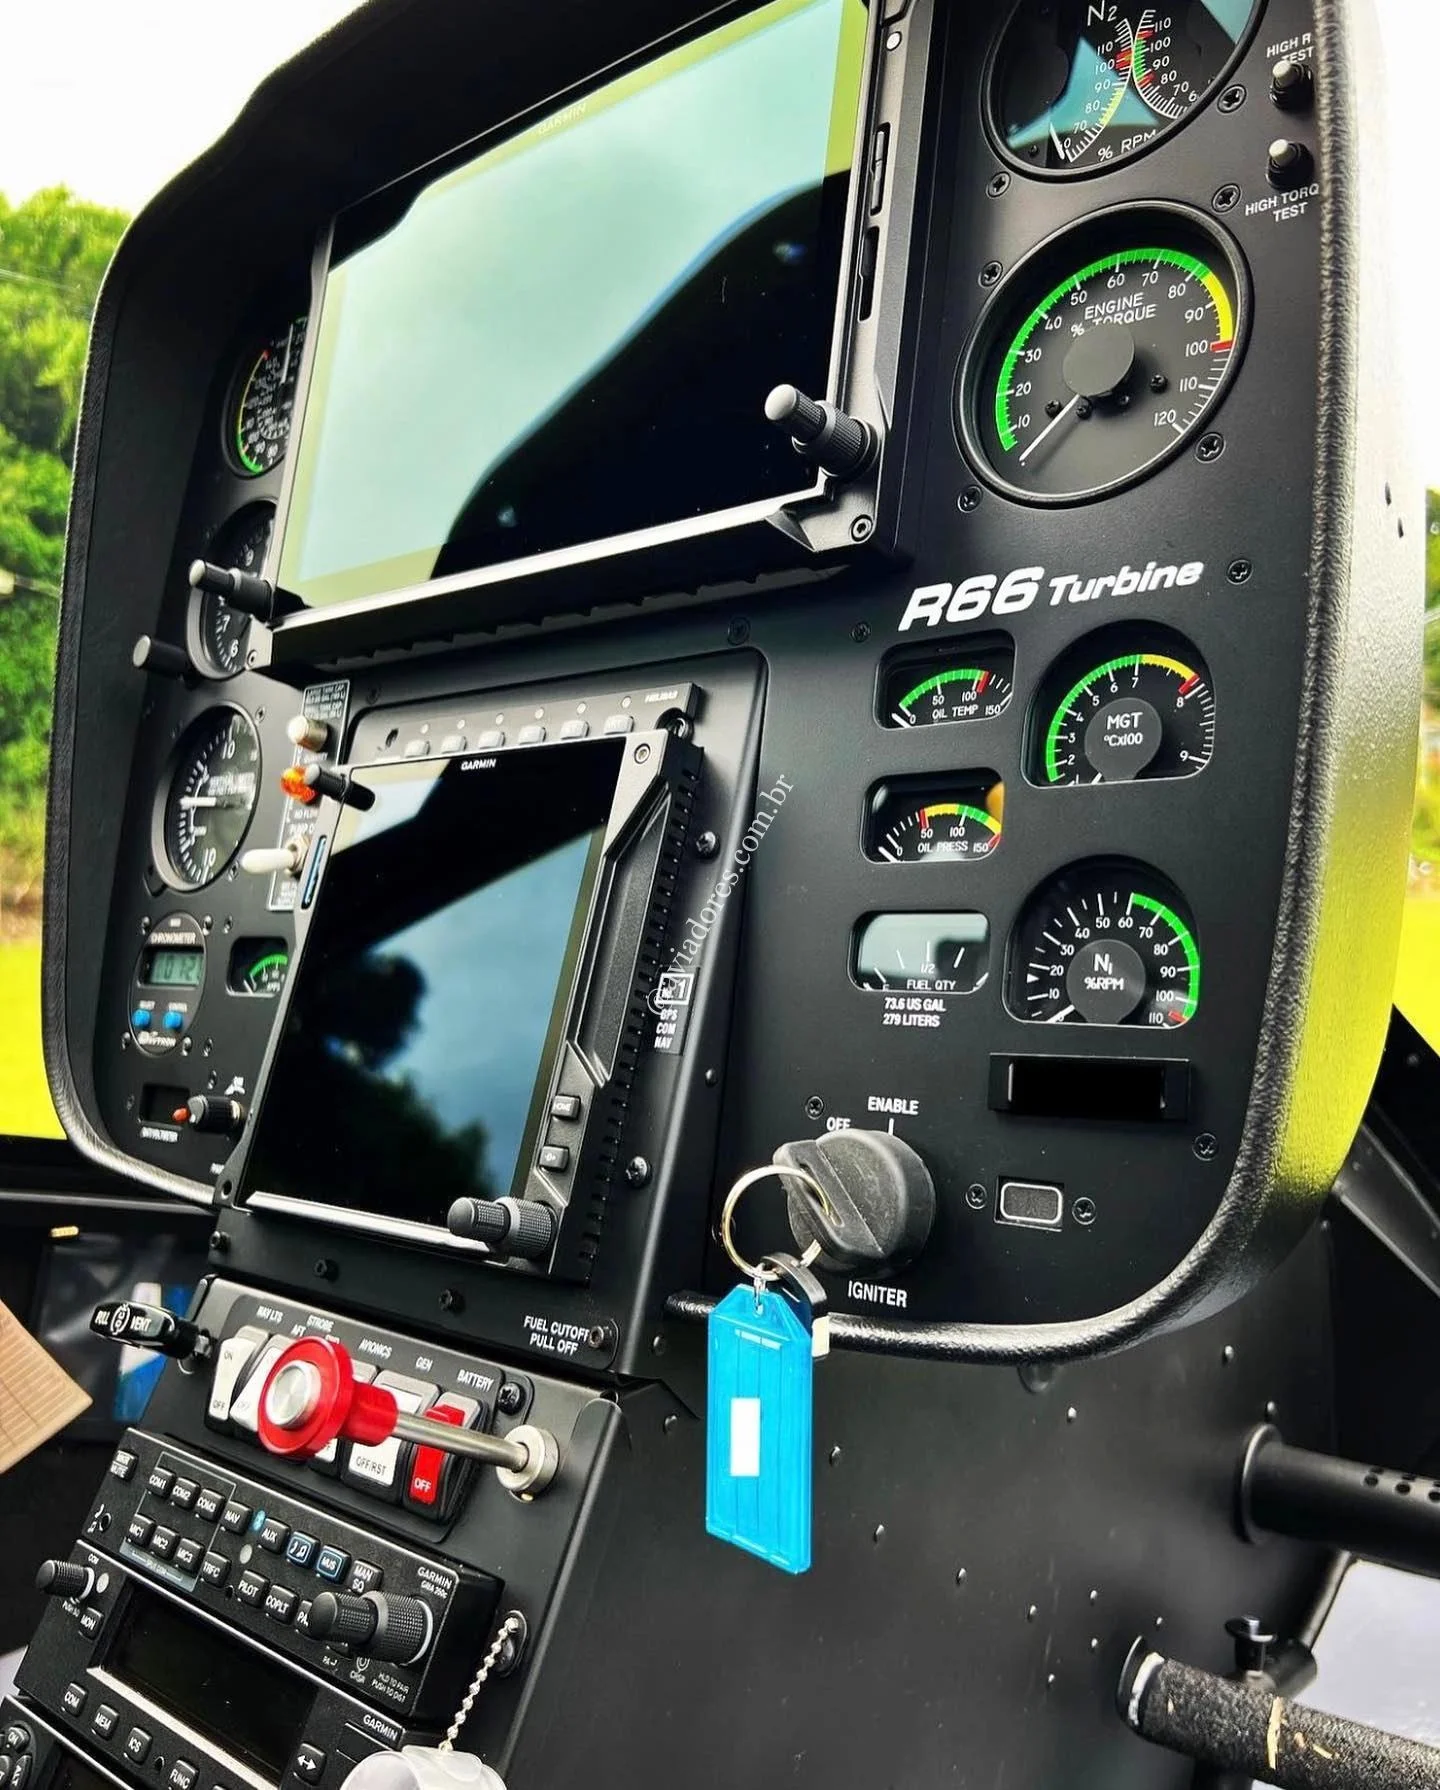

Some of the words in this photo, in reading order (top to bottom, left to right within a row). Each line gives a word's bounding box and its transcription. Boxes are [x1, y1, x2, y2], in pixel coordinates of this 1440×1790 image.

[1154, 17, 1172, 33] 110
[1097, 41, 1113, 56] 110
[1150, 37, 1172, 53] 100
[1266, 40, 1300, 58] HIGH
[1282, 47, 1314, 62] TEST
[1094, 59, 1115, 75] 100
[1152, 55, 1170, 72] 90
[1160, 70, 1178, 85] 80
[1094, 79, 1111, 92] 90
[1173, 81, 1190, 97] 70
[1085, 99, 1100, 114] 80
[1073, 120, 1088, 133] 70
[1097, 146, 1113, 161] %
[1120, 129, 1158, 154] RPM
[1245, 198, 1278, 217] HIGH
[1280, 183, 1320, 205] TORQ
[1273, 202, 1308, 223] TEST
[1107, 272, 1125, 289] 60
[1141, 271, 1159, 287] 70
[1070, 291, 1087, 306] 50
[1168, 283, 1186, 299] 80
[1084, 292, 1144, 320] ENGINE
[1092, 303, 1157, 326] TORQUE
[1184, 307, 1204, 324] 90
[1044, 317, 1062, 331] 40
[1025, 348, 1042, 363] 30
[1185, 340, 1208, 357] 100
[1014, 382, 1032, 397] 20
[1179, 376, 1198, 393] 110
[1017, 415, 1031, 429] 10
[1153, 408, 1176, 427] 120
[898, 566, 1045, 632] R66
[1048, 561, 1204, 607] Turbine
[222, 615, 231, 632] 7
[1110, 681, 1119, 694] 6
[1132, 676, 1140, 689] 7
[932, 694, 945, 706] 50
[961, 691, 978, 703] 100
[1092, 695, 1101, 707] 5
[1176, 696, 1185, 708] 8
[931, 708, 948, 719] OIL
[952, 704, 979, 718] TEMP
[985, 704, 1001, 716] 150
[1076, 711, 1085, 723] 4
[1106, 712, 1143, 731] MGT
[1068, 732, 1077, 743] 3
[222, 740, 235, 759] 10
[1180, 750, 1189, 762] 9
[461, 759, 497, 771] GARMIN
[1067, 754, 1076, 765] 2
[920, 827, 934, 839] 50
[949, 826, 965, 838] 100
[917, 842, 933, 853] OIL
[937, 841, 969, 852] PRESS
[973, 843, 989, 854] 150
[204, 848, 216, 867] 10
[1096, 917, 1110, 929] 50
[1118, 917, 1133, 929] 60
[1075, 928, 1090, 939] 40
[1139, 927, 1154, 939] 70
[1060, 944, 1075, 956] 30
[1154, 944, 1169, 957] 80
[1049, 965, 1064, 977] 20
[1160, 966, 1176, 979] 90
[678, 979, 687, 999] 1
[906, 980, 932, 991] FUEL
[934, 979, 956, 992] QTY
[1084, 977, 1125, 991] %RPM
[1048, 988, 1060, 999] 10
[1155, 990, 1175, 1003] 100
[884, 998, 905, 1010] 73.6
[906, 999, 922, 1011] US
[923, 999, 946, 1012] GAL
[882, 1014, 901, 1026] 279
[902, 1014, 940, 1028] LITERS
[1149, 1012, 1164, 1024] 110
[654, 1036, 673, 1049] NAV
[867, 1096, 919, 1115] ENABLE
[826, 1117, 851, 1131] OFF
[848, 1280, 908, 1308] IGNITER
[130, 1316, 152, 1333] VENT
[291, 1324, 306, 1337] AFT
[523, 1315, 549, 1335] FUEL
[551, 1321, 590, 1341] CUTOFF
[358, 1338, 393, 1359] AVIONICS
[529, 1333, 555, 1350] PULL
[557, 1338, 578, 1355] OFF
[415, 1355, 432, 1372] GEN
[456, 1368, 494, 1392] BATTERY
[213, 1399, 226, 1411] OFF
[355, 1456, 387, 1477] OFF/RST
[149, 1475, 166, 1490] COM1
[413, 1476, 432, 1492] OFF
[172, 1485, 191, 1500] COM2
[197, 1497, 216, 1512] COM3
[225, 1509, 241, 1525] NAV
[129, 1523, 144, 1537] MIC1
[261, 1527, 277, 1543] AUX
[153, 1534, 168, 1549] MIC2
[177, 1547, 193, 1563] MIC3
[203, 1561, 220, 1578] TRFC
[321, 1557, 337, 1570] MUS
[354, 1565, 373, 1582] MAN
[417, 1567, 452, 1589] GARMIN
[238, 1579, 259, 1598] PILOT
[265, 1594, 290, 1615] COPLT
[80, 1614, 97, 1631] MON
[64, 1690, 80, 1708] COM
[95, 1713, 112, 1730] MEM
[363, 1714, 398, 1740] GARMIN
[129, 1737, 141, 1752] ICS
[170, 1770, 191, 1790] FUNC
